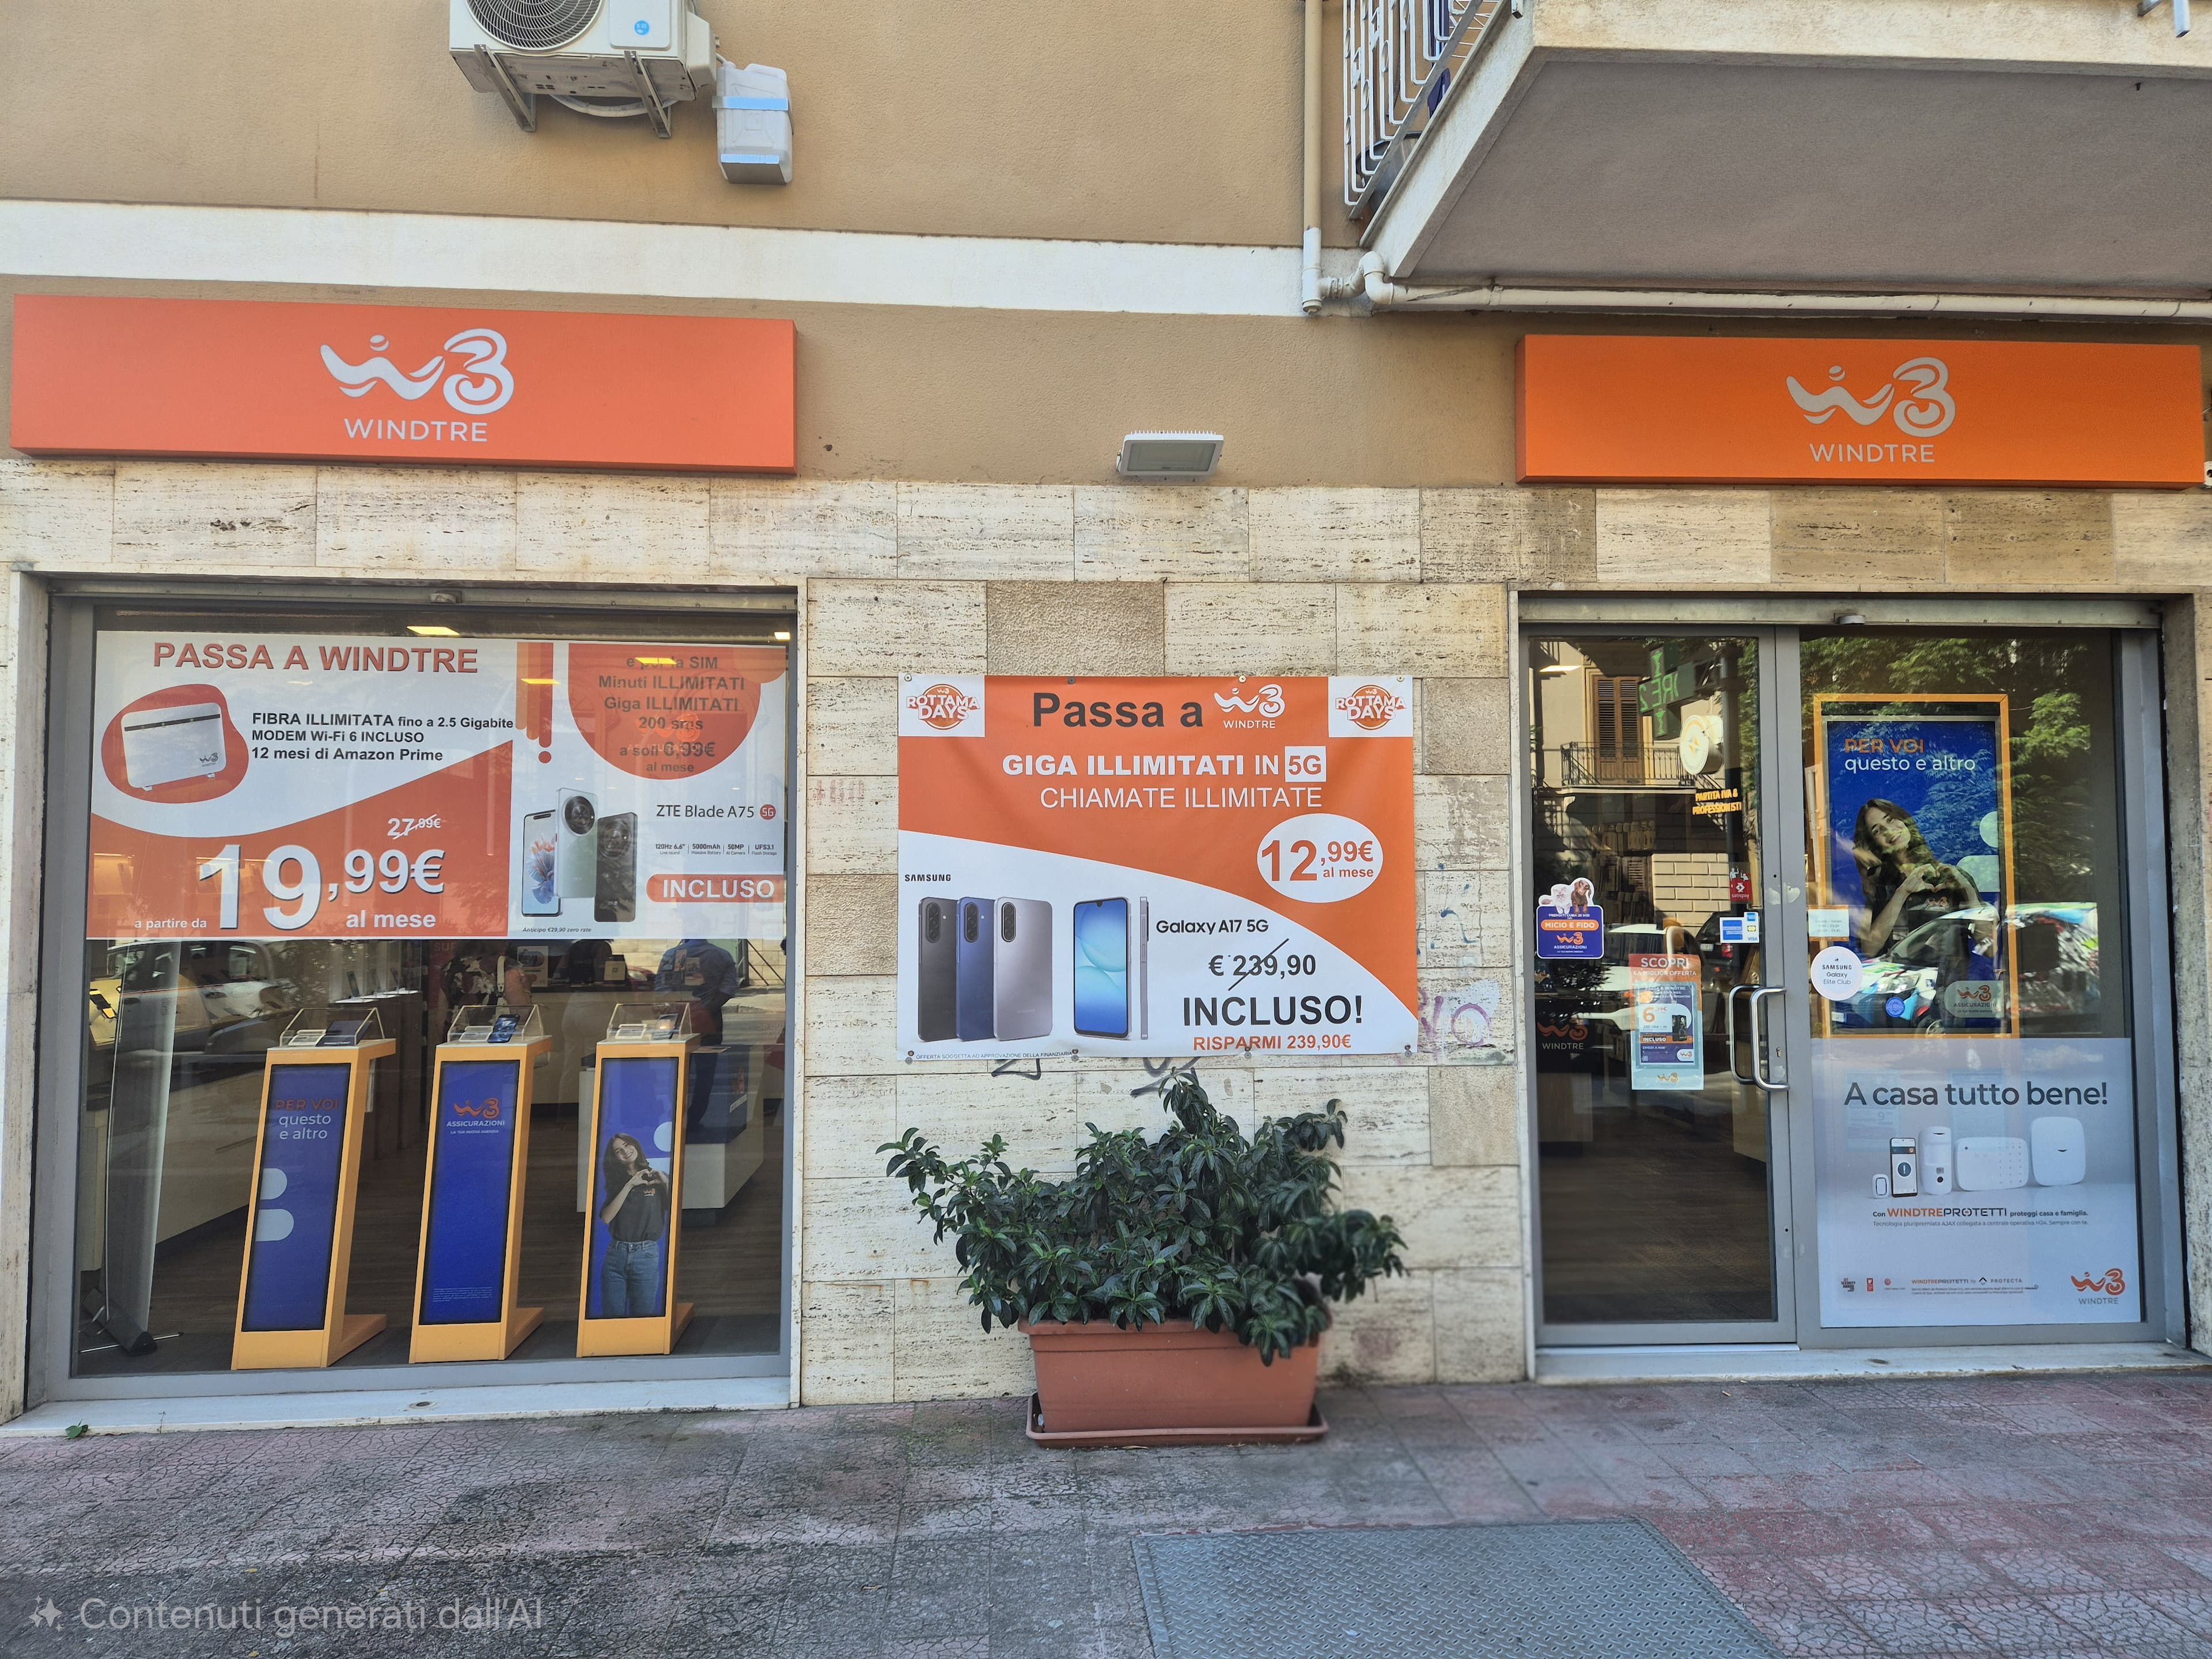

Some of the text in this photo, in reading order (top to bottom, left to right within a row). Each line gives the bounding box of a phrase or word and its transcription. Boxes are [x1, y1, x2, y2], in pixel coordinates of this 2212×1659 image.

[344, 418, 487, 442] WINDTRE
[1809, 444, 1935, 462] WINDTRE
[153, 642, 478, 673] PASSA A WINDTRE
[690, 657, 718, 669] SIM
[599, 676, 745, 690] Minuti ILLIMITATI
[604, 697, 738, 713] Giga ILLIMITATI
[906, 694, 980, 709] ROTTAMA
[1335, 695, 1406, 709] ROTTAMA
[918, 704, 968, 719] DAYS
[1033, 692, 1203, 727] Passa a
[1347, 705, 1396, 719] DAYS
[252, 713, 513, 730] FIBRA ILLIMITATA fino a 2.5 Gigabite
[638, 717, 703, 730] 200 sms
[1224, 720, 1275, 729] WINDTRE
[252, 730, 425, 743] MODEM Wi-Fi 6 INCLUSO
[620, 747, 628, 756] a
[1845, 738, 1925, 753] PER VOI
[252, 747, 443, 761] 12 mesi di Amazon Prime
[646, 762, 694, 772] al mese
[1003, 755, 1321, 775] GIGA ILLIMITATI IN 5G
[1845, 755, 1976, 774] questo e altro
[1040, 787, 1322, 809] CHIAMATE ILLIMITATE
[1695, 790, 1720, 801] PARTITA
[656, 805, 774, 818] ZTE Blade A75 5G
[1262, 840, 1374, 881] 12,99€
[1323, 867, 1374, 878] al mese
[199, 844, 445, 931] 19,99€
[663, 880, 775, 898] INCLUSO
[134, 918, 207, 931] a partire da
[346, 910, 436, 929] al mese
[1156, 920, 1268, 934] Galaxy A17 5G
[1209, 954, 1316, 979] € 239,90
[1641, 957, 1690, 968] SCOPRI
[1183, 995, 1362, 1026] INCLUSO!
[1193, 1035, 1351, 1051] RISPARMI 239,90€
[1844, 1081, 2108, 1105] A casa tutto bene!
[275, 1099, 339, 1111] PER VOI
[279, 1113, 331, 1128] questo
[279, 1127, 327, 1140] e altro
[1887, 1208, 2006, 1217] WINDTREPROTETTI
